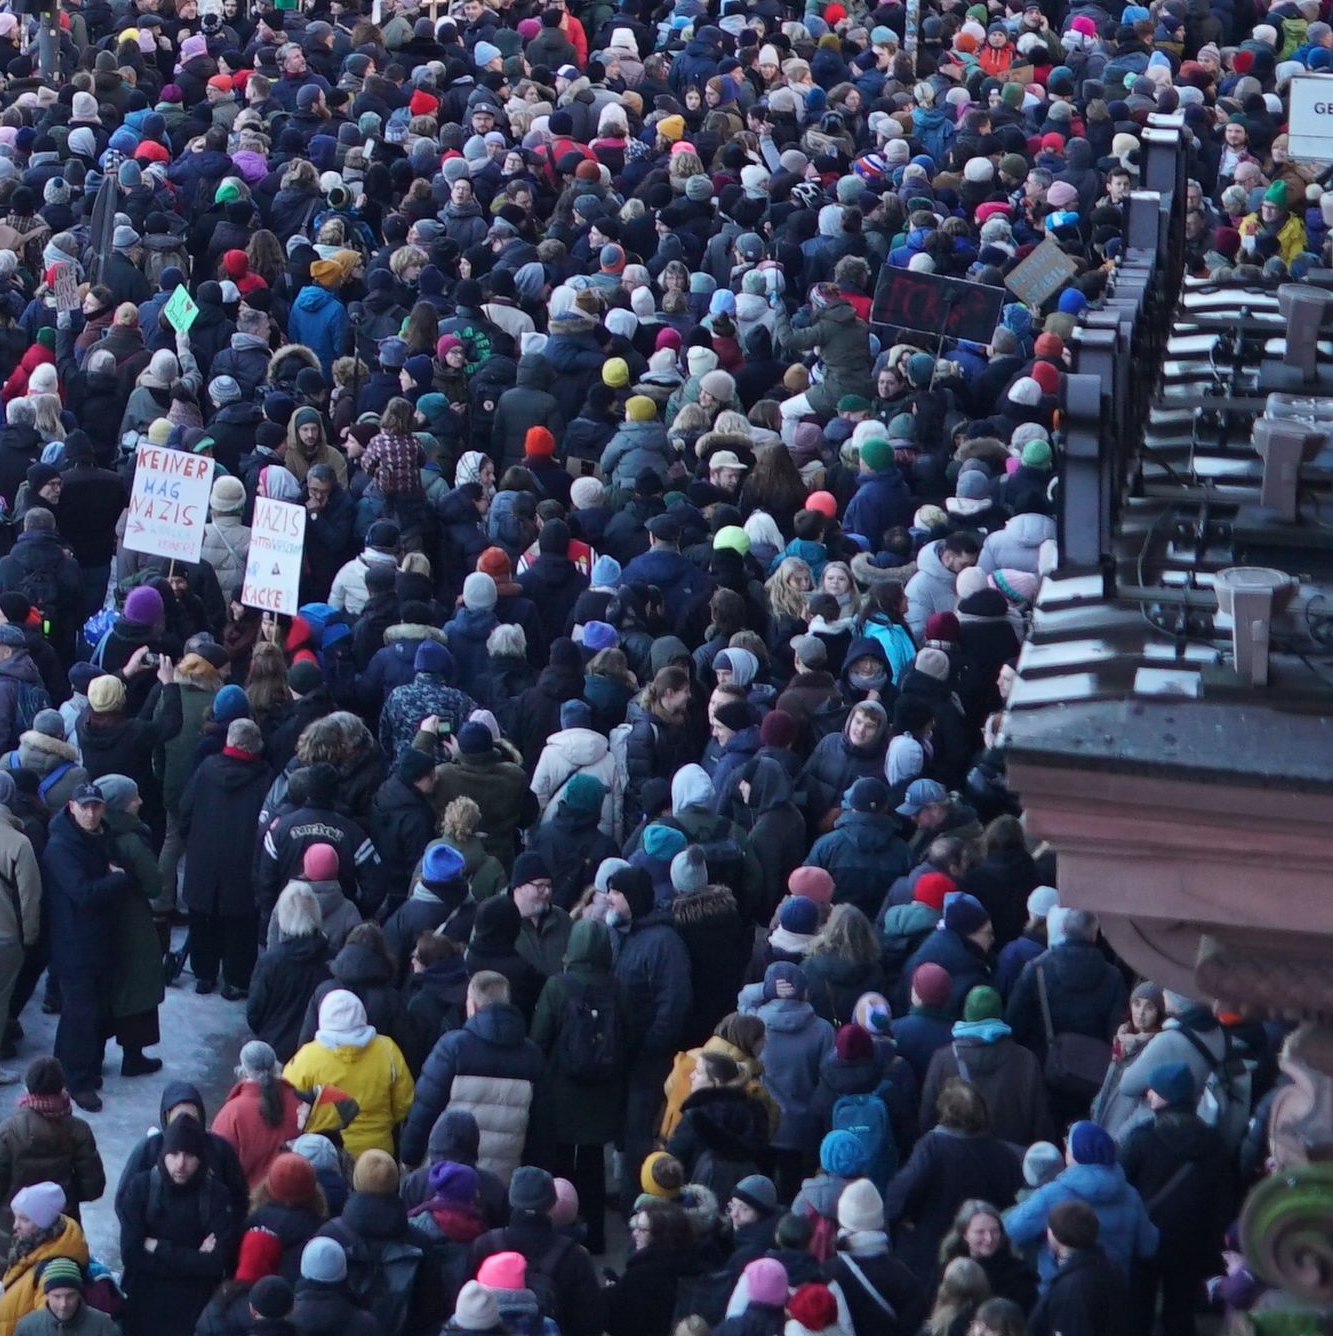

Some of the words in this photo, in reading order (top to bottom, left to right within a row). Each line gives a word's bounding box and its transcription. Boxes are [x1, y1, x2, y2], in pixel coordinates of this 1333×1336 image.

[55, 265, 77, 281] LOVE
[56, 278, 77, 297] LOVE
[56, 293, 80, 312] LOVE
[136, 447, 209, 481] KEINER
[144, 474, 182, 500] MAG
[128, 494, 199, 527] NAZIS
[253, 502, 301, 538] NAZIS
